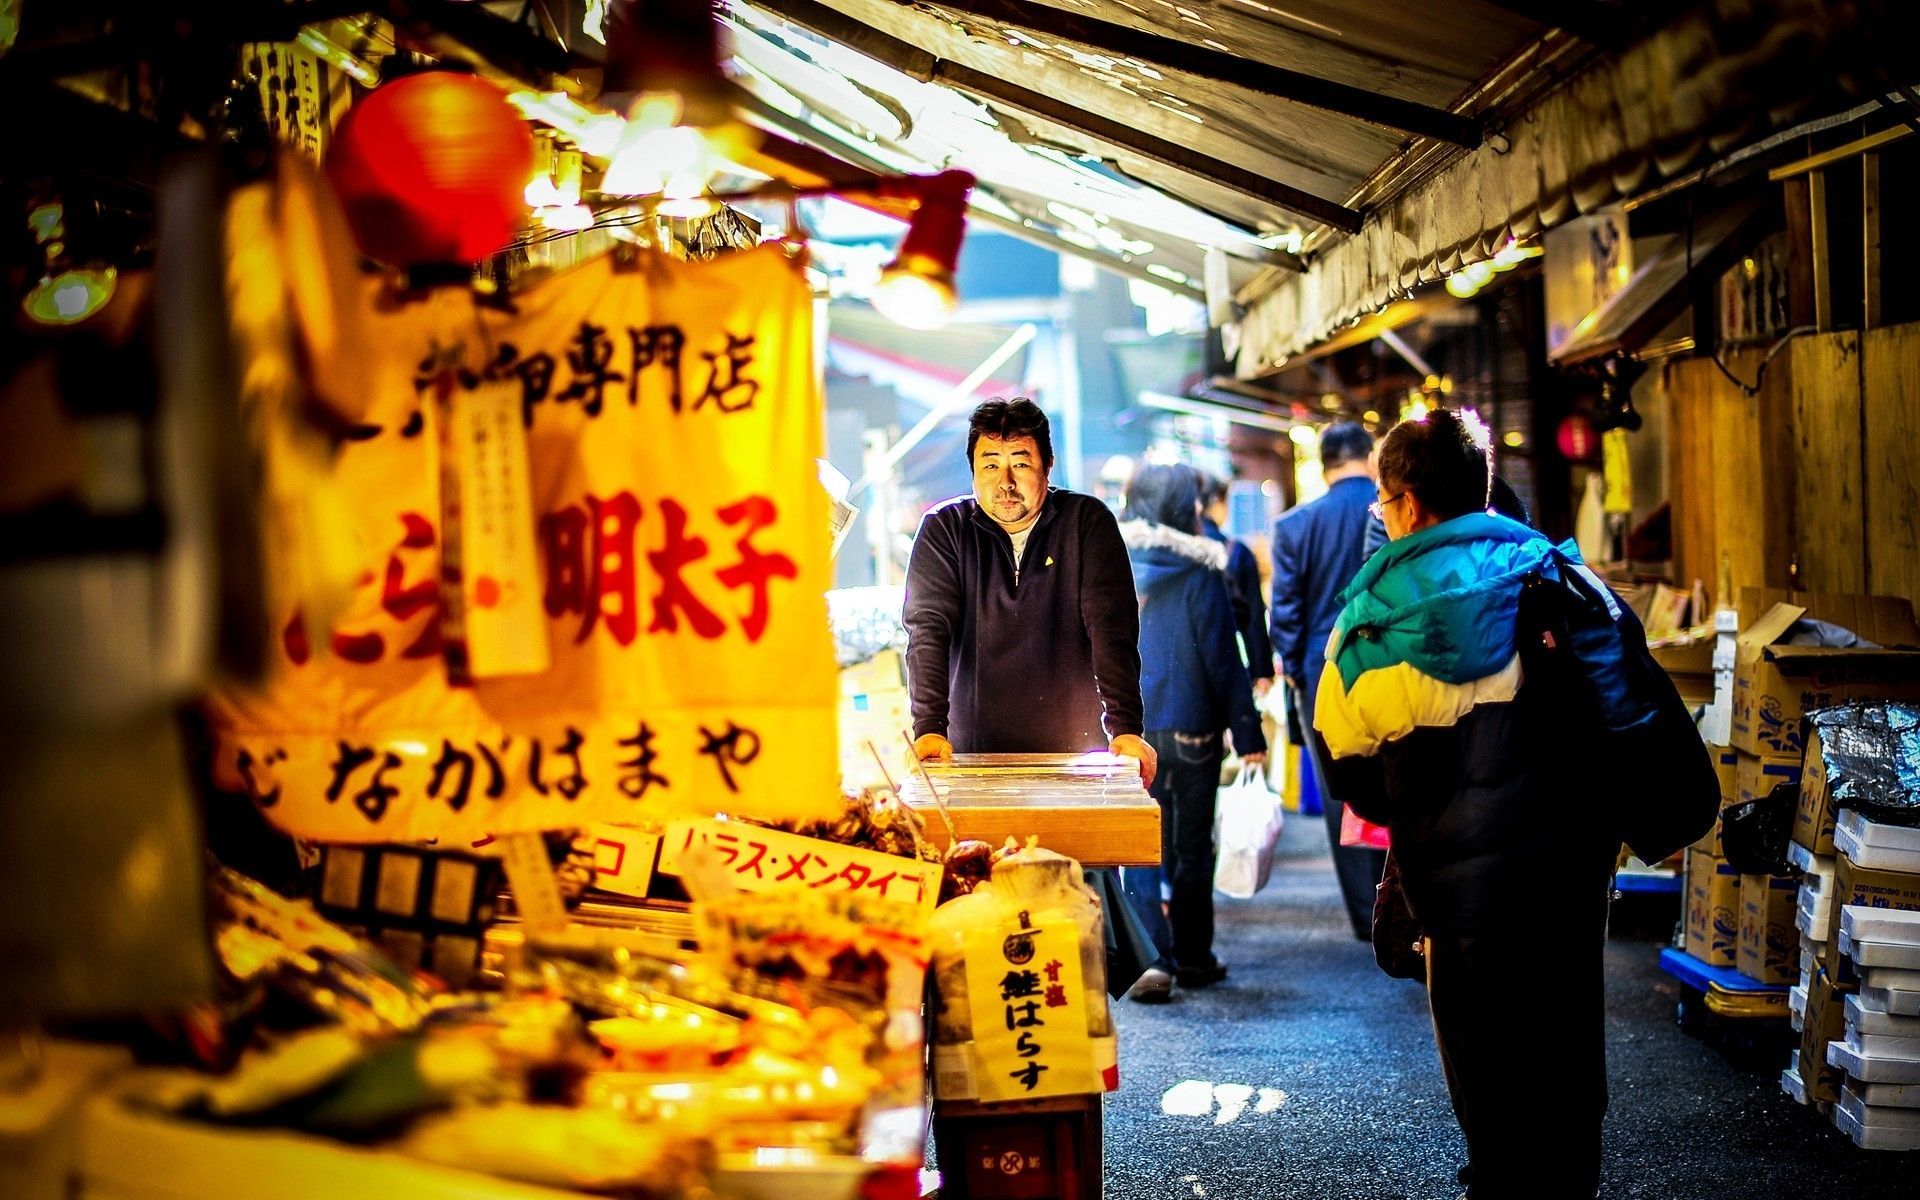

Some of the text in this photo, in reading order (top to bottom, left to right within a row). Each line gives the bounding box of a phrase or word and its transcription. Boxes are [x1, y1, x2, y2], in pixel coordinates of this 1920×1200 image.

[539, 490, 798, 647] 明太子
[998, 969, 1049, 1092] 鮭はらす
